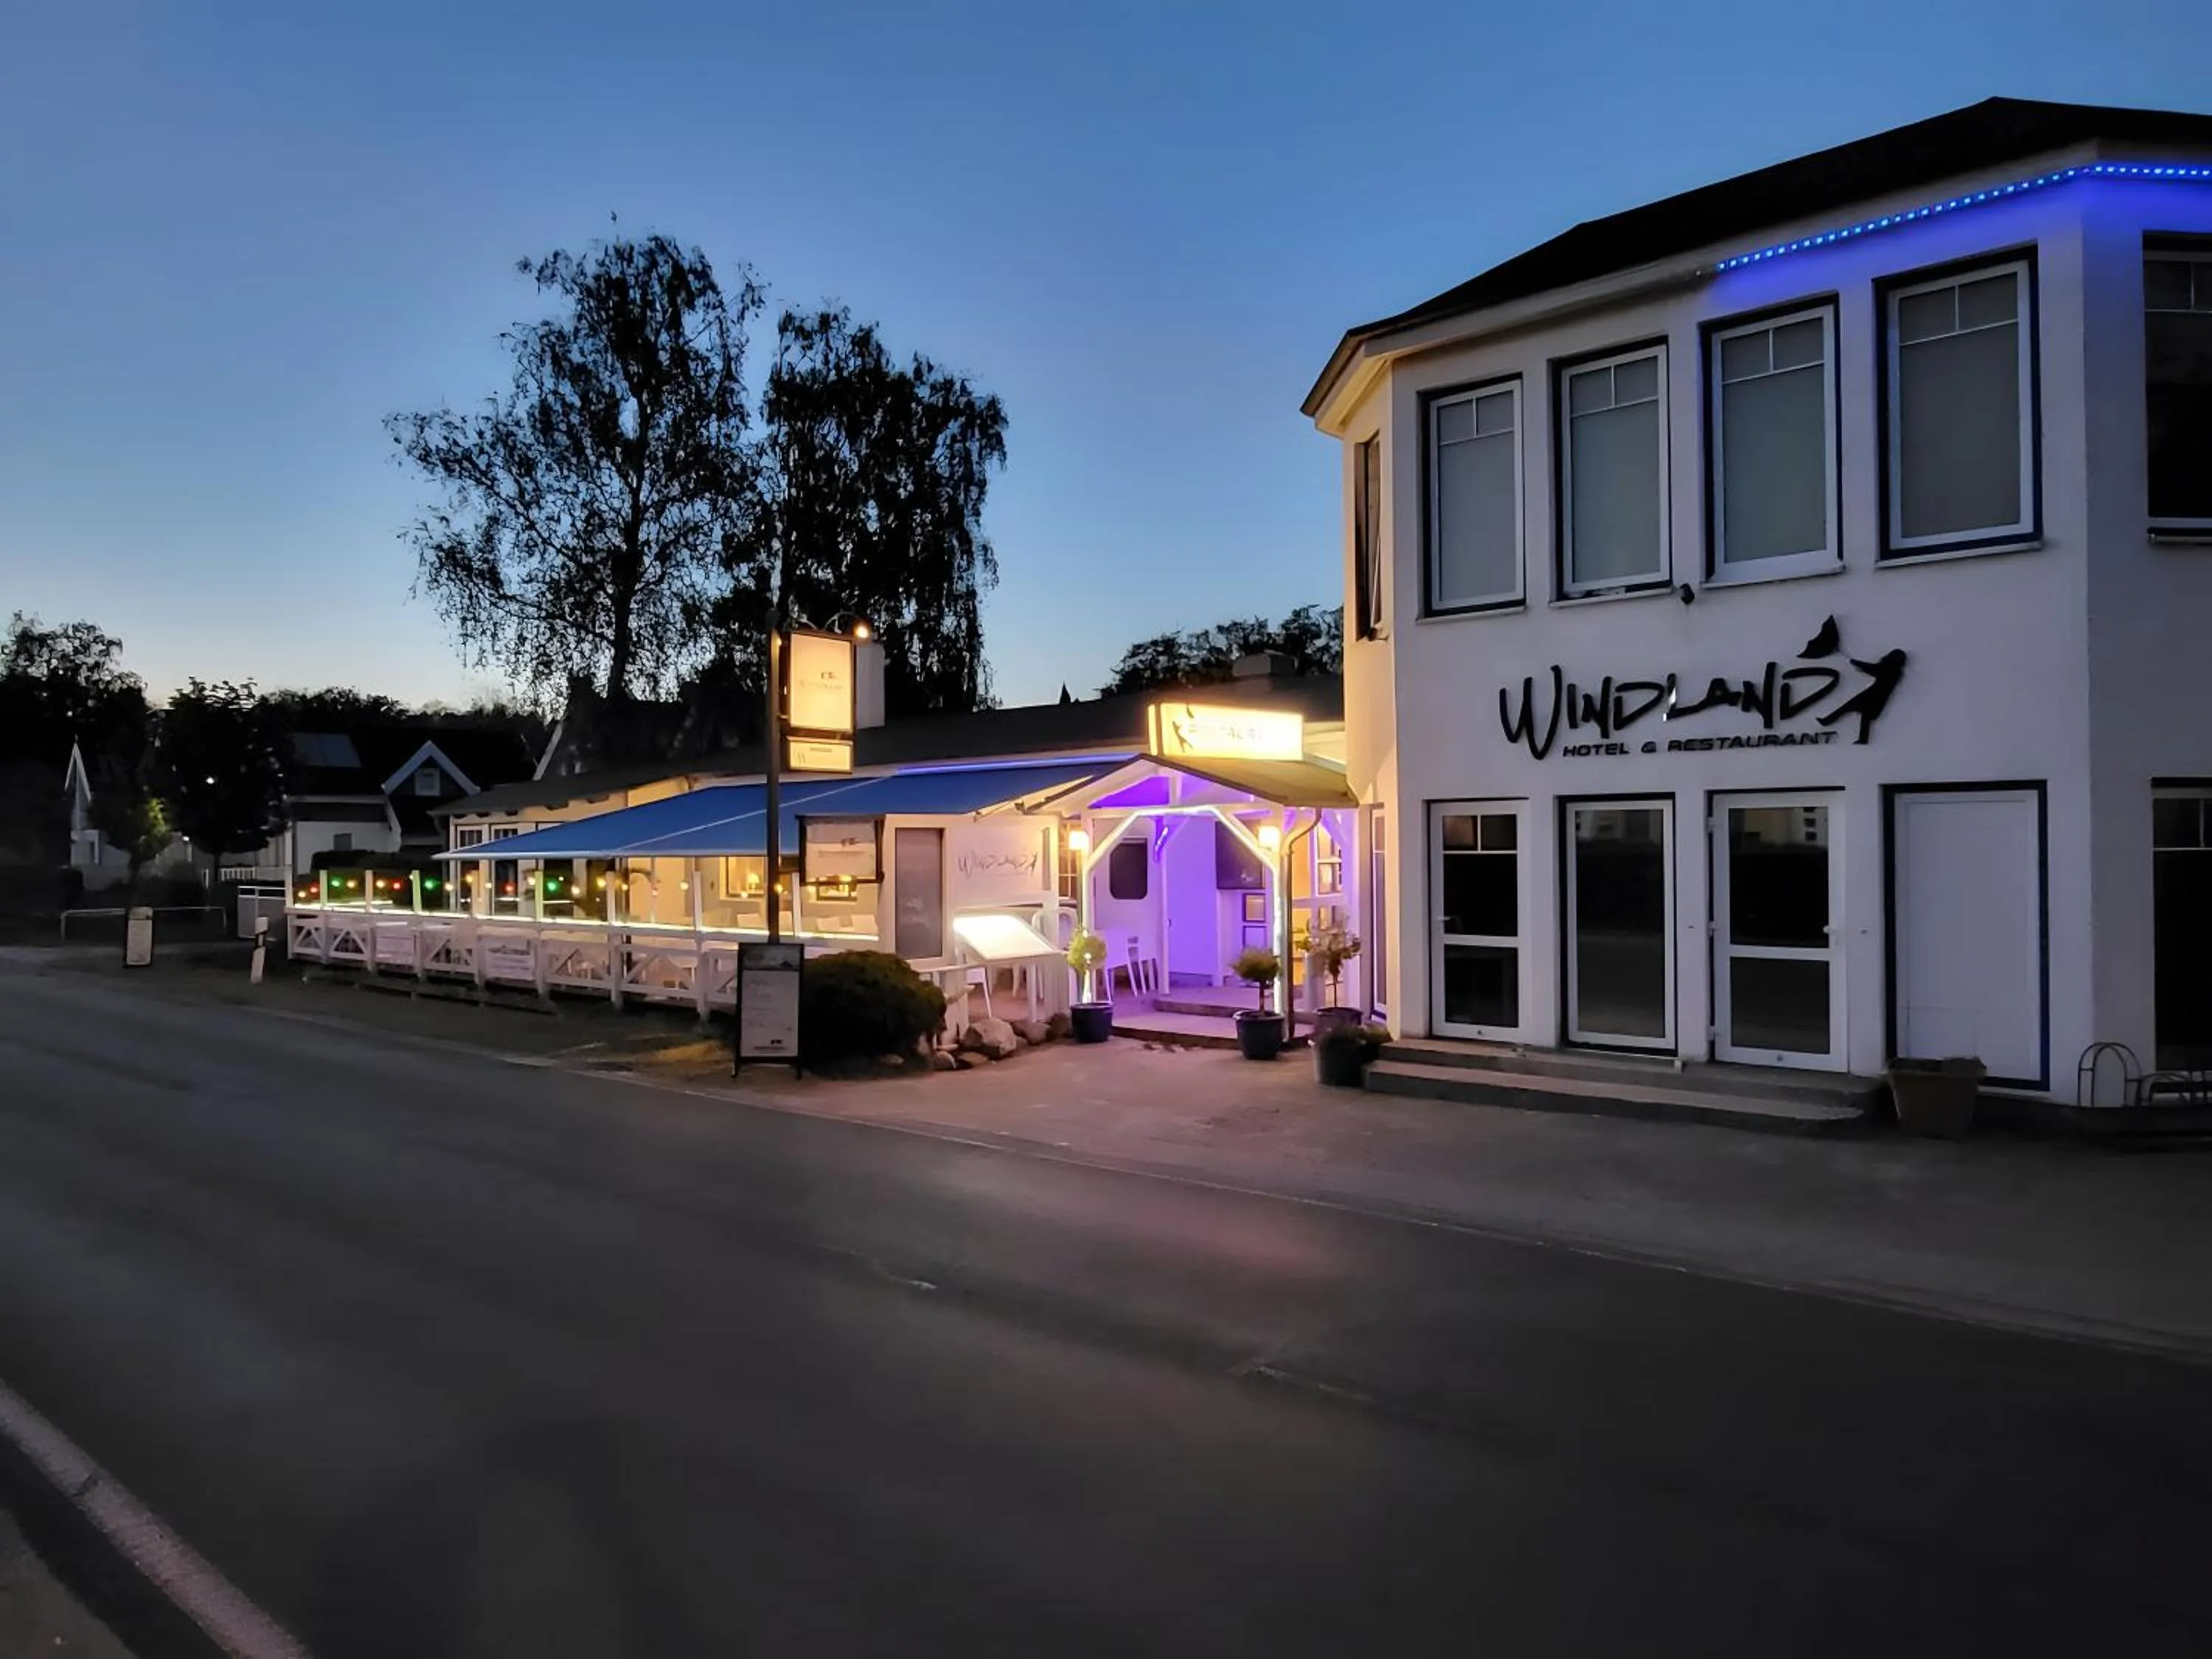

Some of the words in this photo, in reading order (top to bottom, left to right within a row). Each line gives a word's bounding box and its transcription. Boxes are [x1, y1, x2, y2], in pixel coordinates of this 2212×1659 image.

[1500, 661, 1840, 759] WINDLAND
[1562, 742, 1629, 757] HOTEL
[1641, 740, 1657, 754] &
[1667, 731, 1838, 752] RESTAURANT
